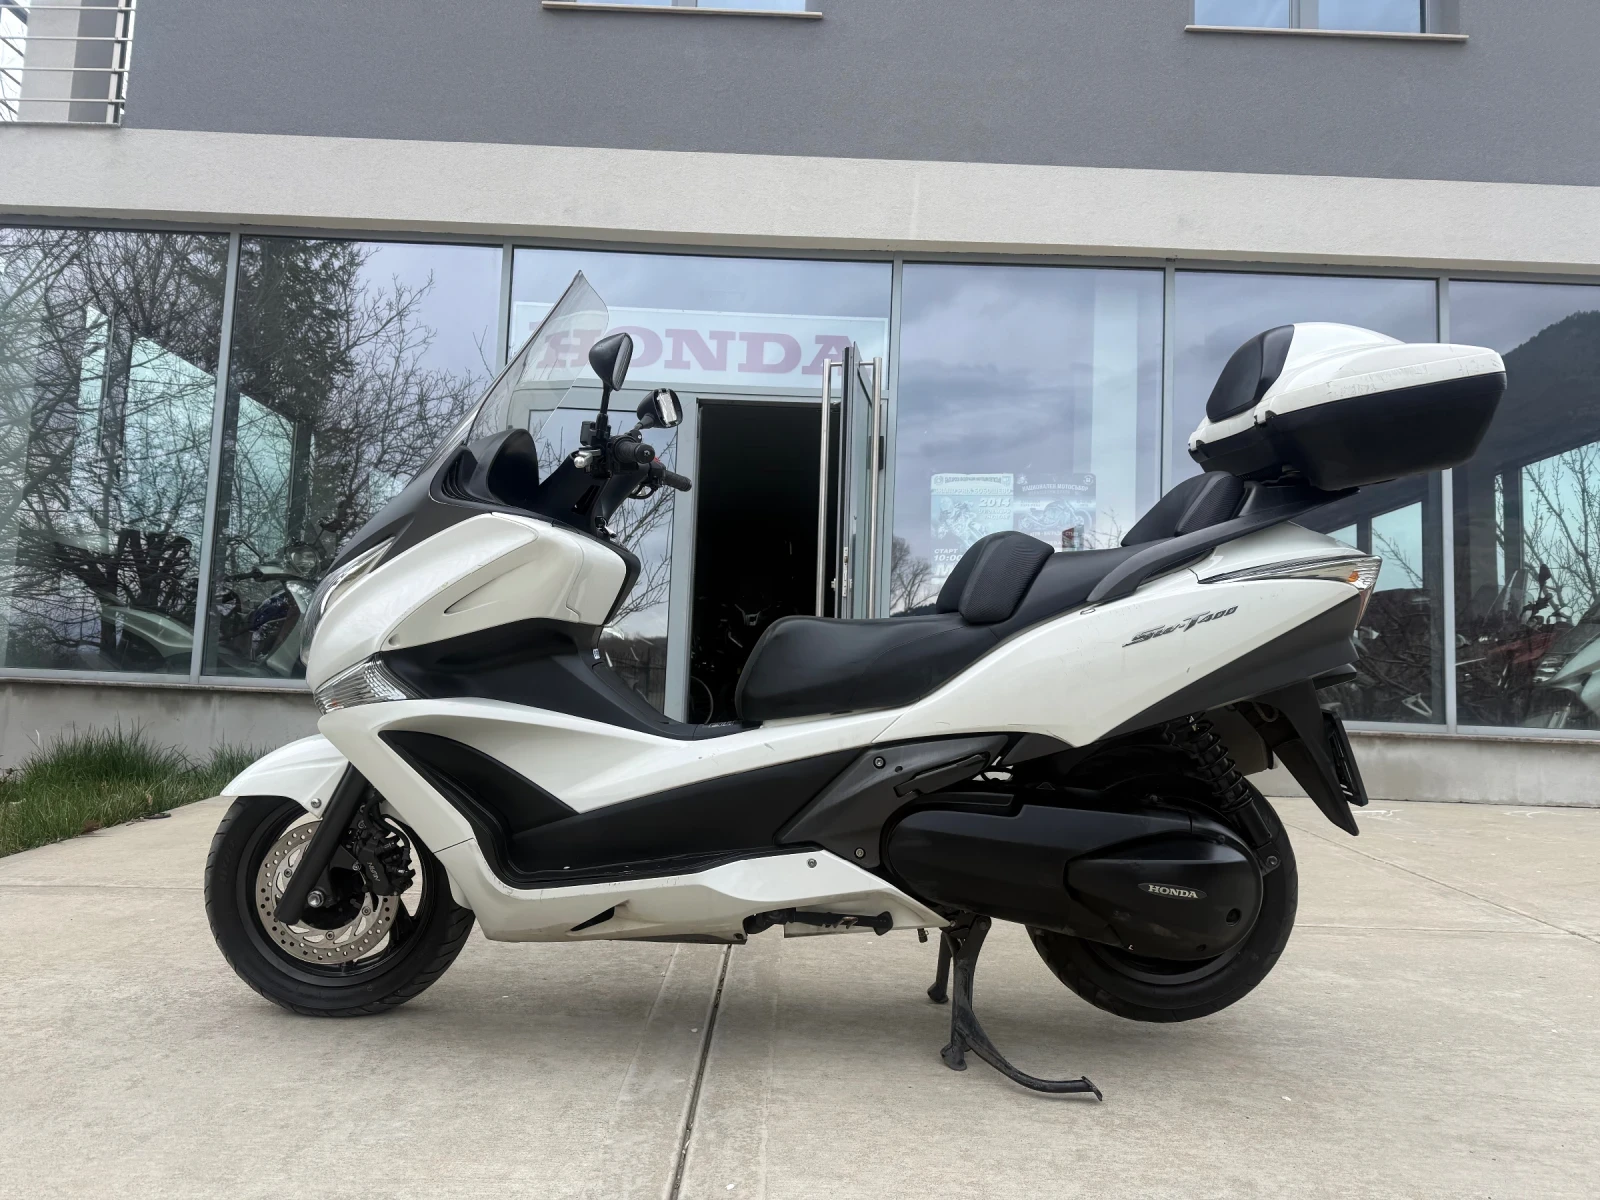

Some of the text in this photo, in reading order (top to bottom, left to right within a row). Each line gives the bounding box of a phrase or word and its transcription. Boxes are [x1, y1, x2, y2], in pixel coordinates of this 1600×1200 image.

[529, 321, 872, 377] HONDA
[978, 497, 1011, 508] 2014
[933, 554, 963, 562] 10:00
[1148, 884, 1198, 899] HONDA
